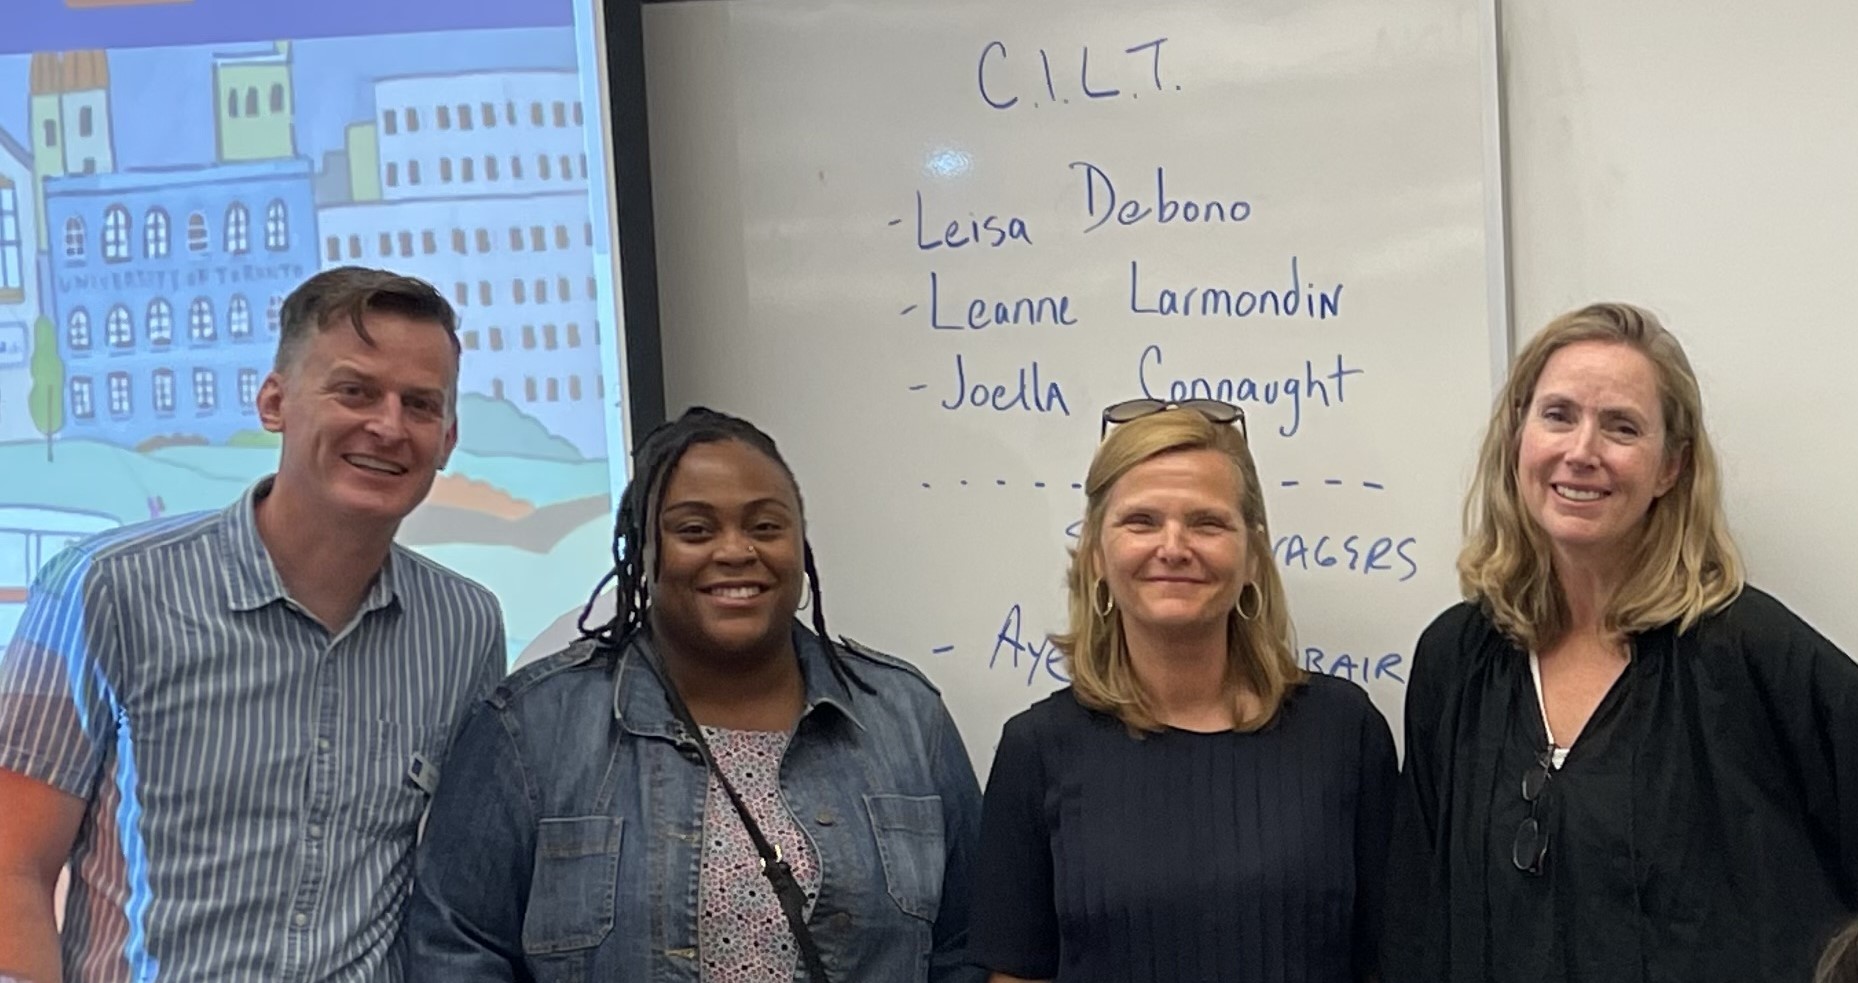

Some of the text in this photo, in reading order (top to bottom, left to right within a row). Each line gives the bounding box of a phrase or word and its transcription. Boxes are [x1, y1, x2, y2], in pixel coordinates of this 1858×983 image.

[978, 37, 1182, 109] C.I.L.T.
[1069, 162, 1251, 234] Debono
[1304, 647, 1406, 684] BAIR
